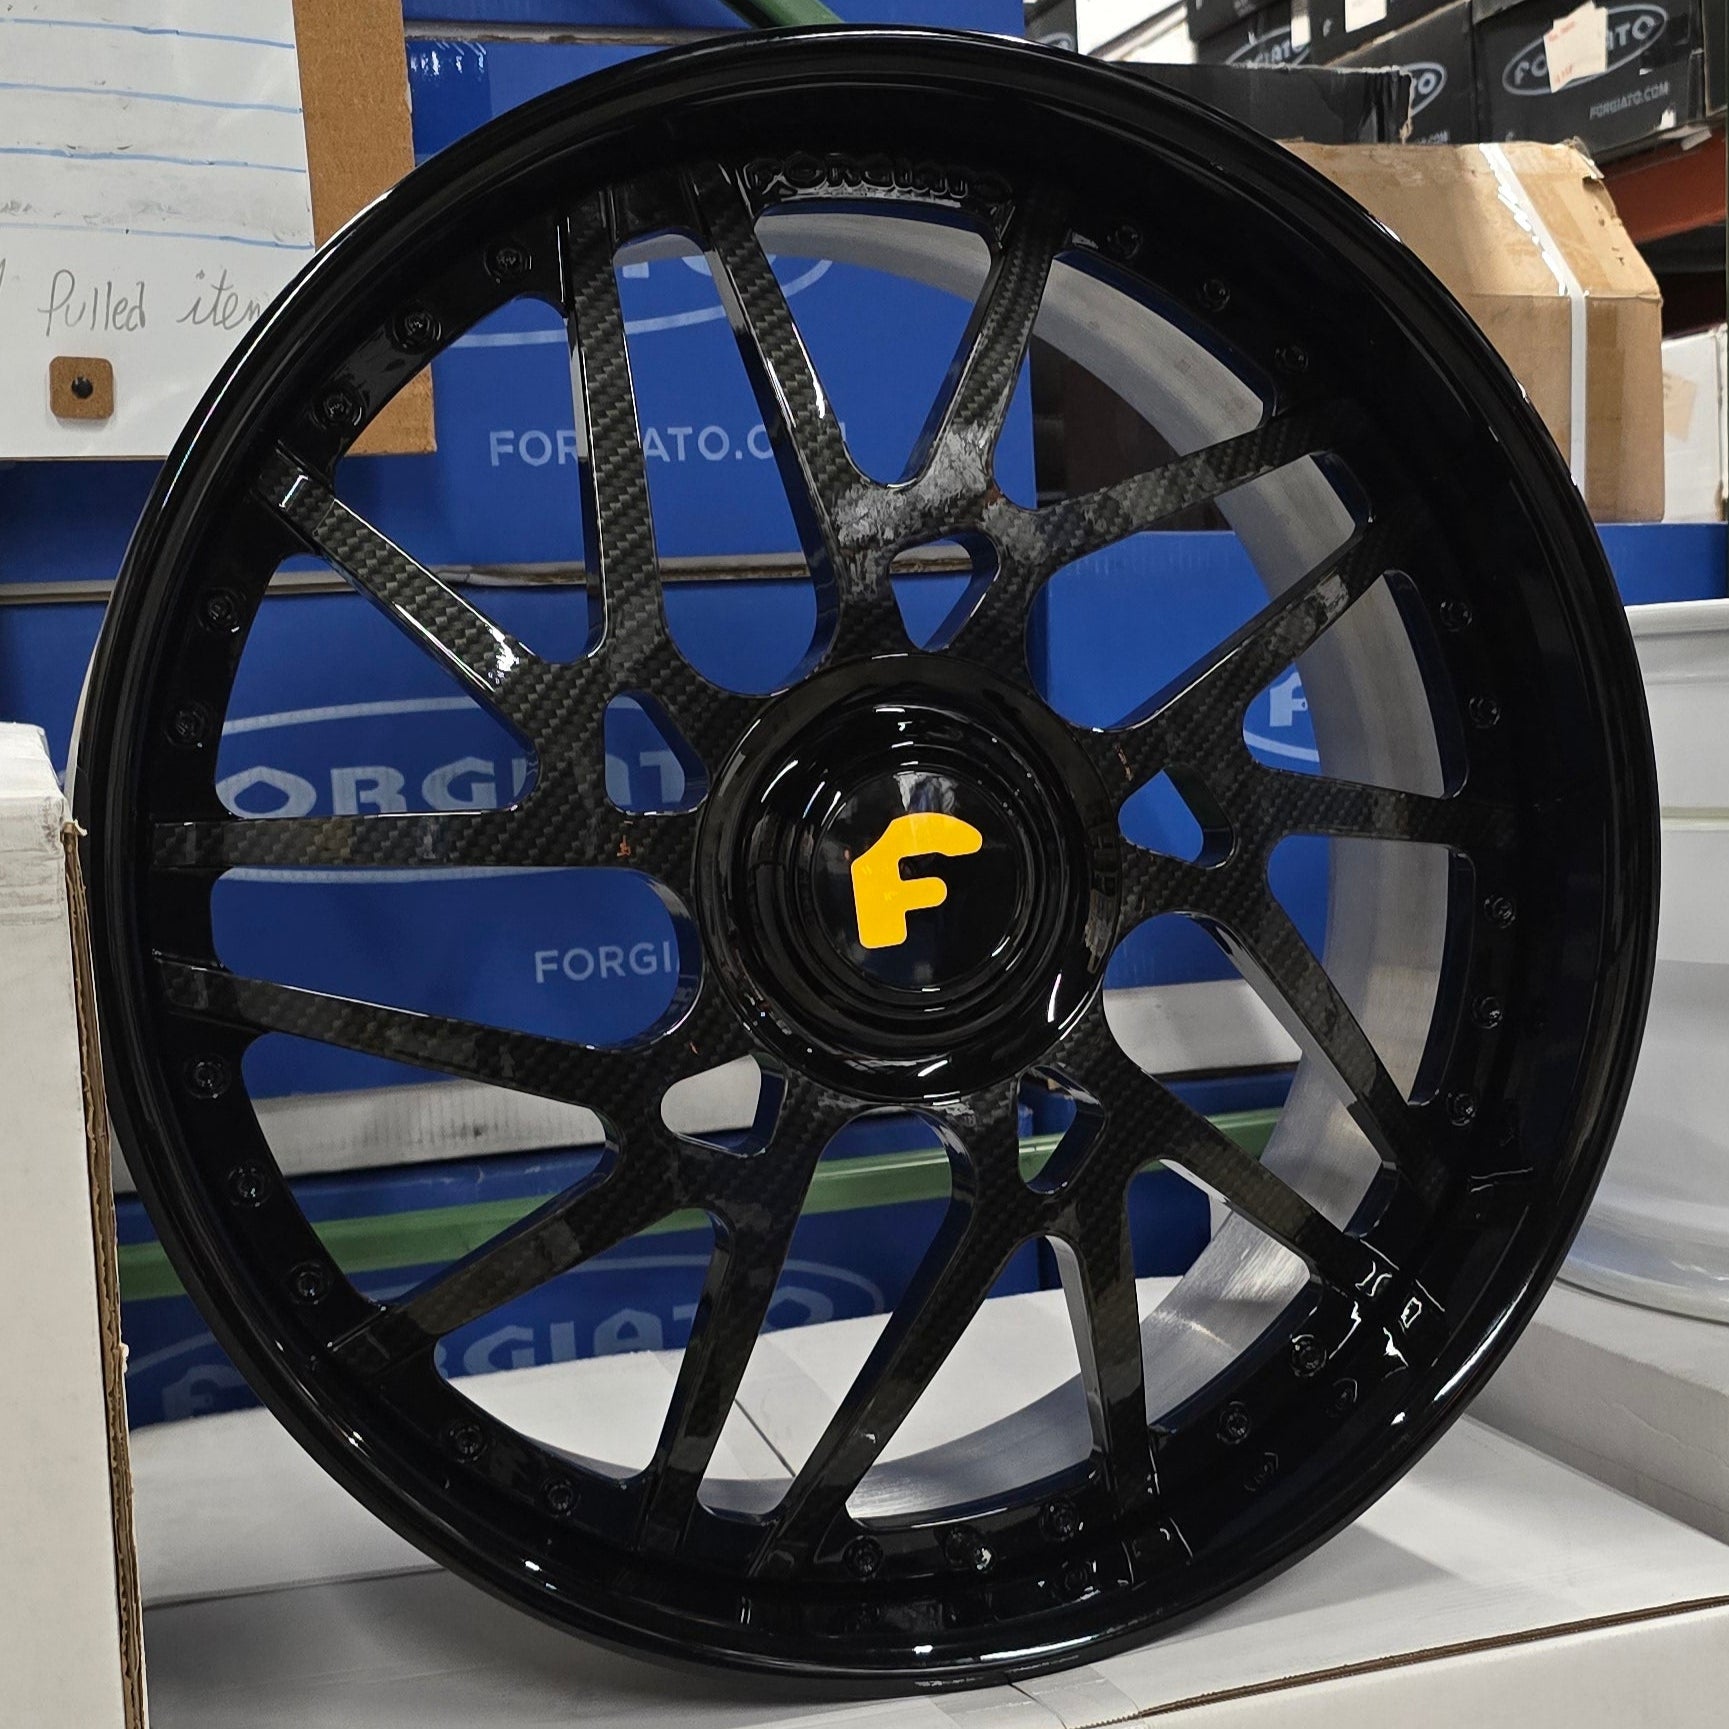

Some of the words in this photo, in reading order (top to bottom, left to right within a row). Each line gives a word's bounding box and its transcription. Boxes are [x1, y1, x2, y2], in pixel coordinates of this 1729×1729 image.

[1513, 15, 1656, 85] FOTO
[1589, 81, 1669, 120] FORGIATO.COM
[489, 421, 846, 467] FORATO.C
[851, 812, 982, 949] F
[534, 940, 681, 984] FORGI
